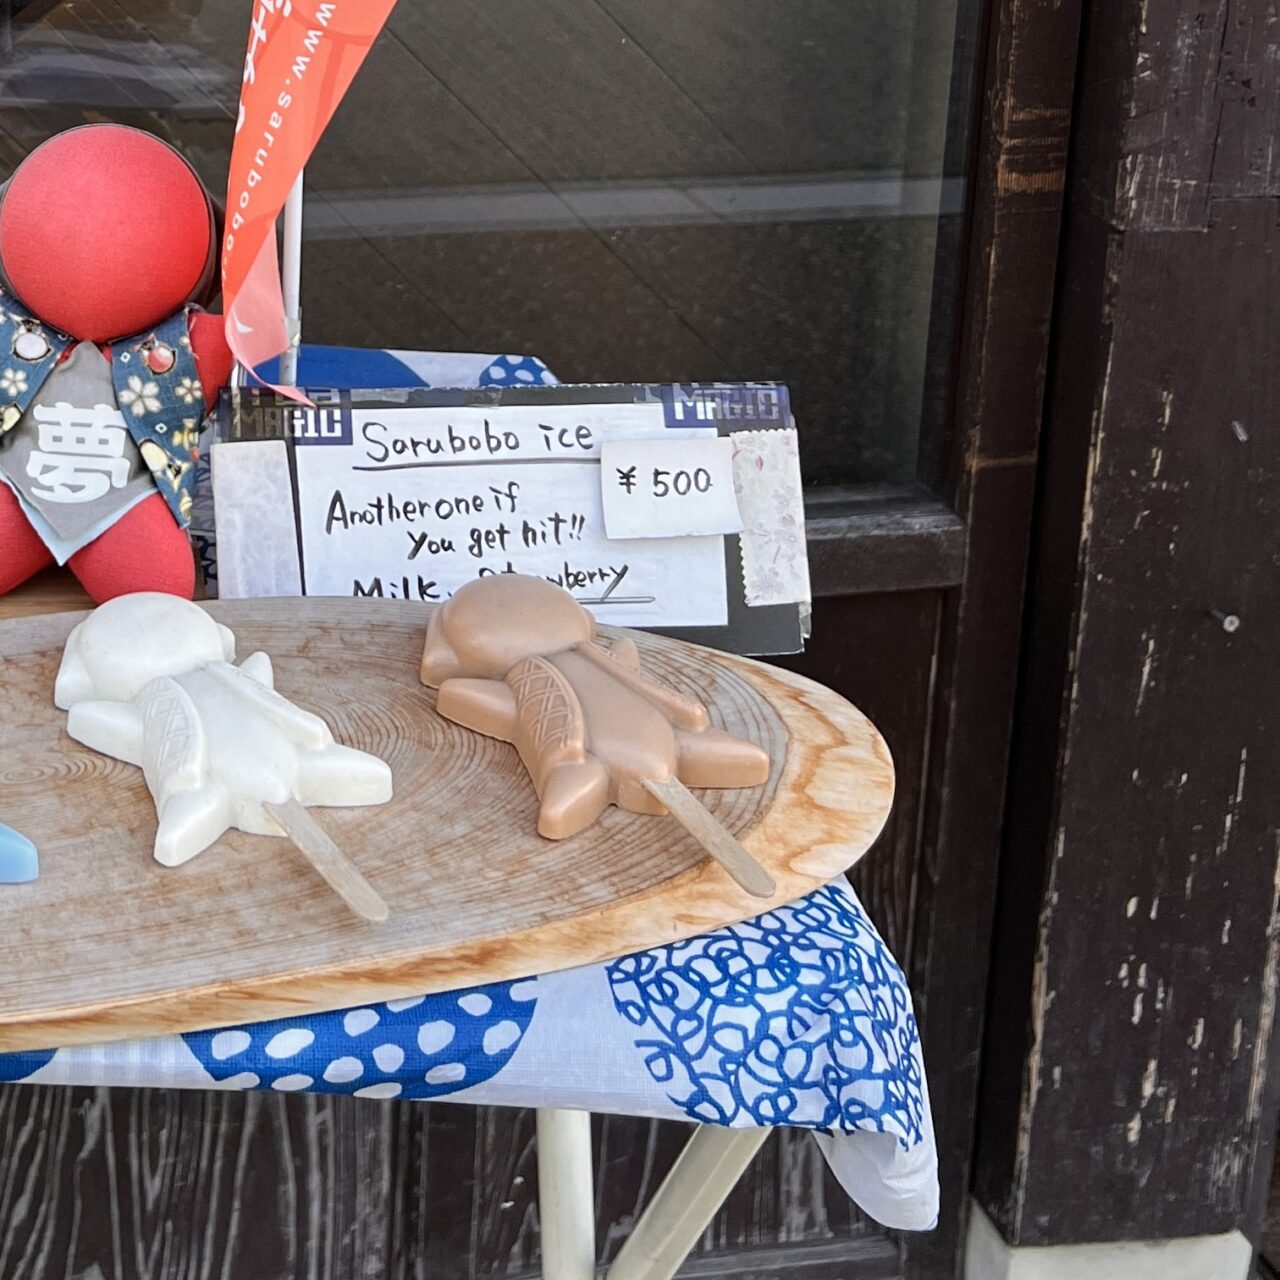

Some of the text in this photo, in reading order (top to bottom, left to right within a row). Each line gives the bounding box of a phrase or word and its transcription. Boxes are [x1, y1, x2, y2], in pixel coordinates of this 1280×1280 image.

[26, 401, 132, 505] 夢
[362, 418, 594, 463] Sarubobo ice
[488, 480, 521, 514] if
[652, 467, 714, 498] 500
[468, 522, 512, 559] get
